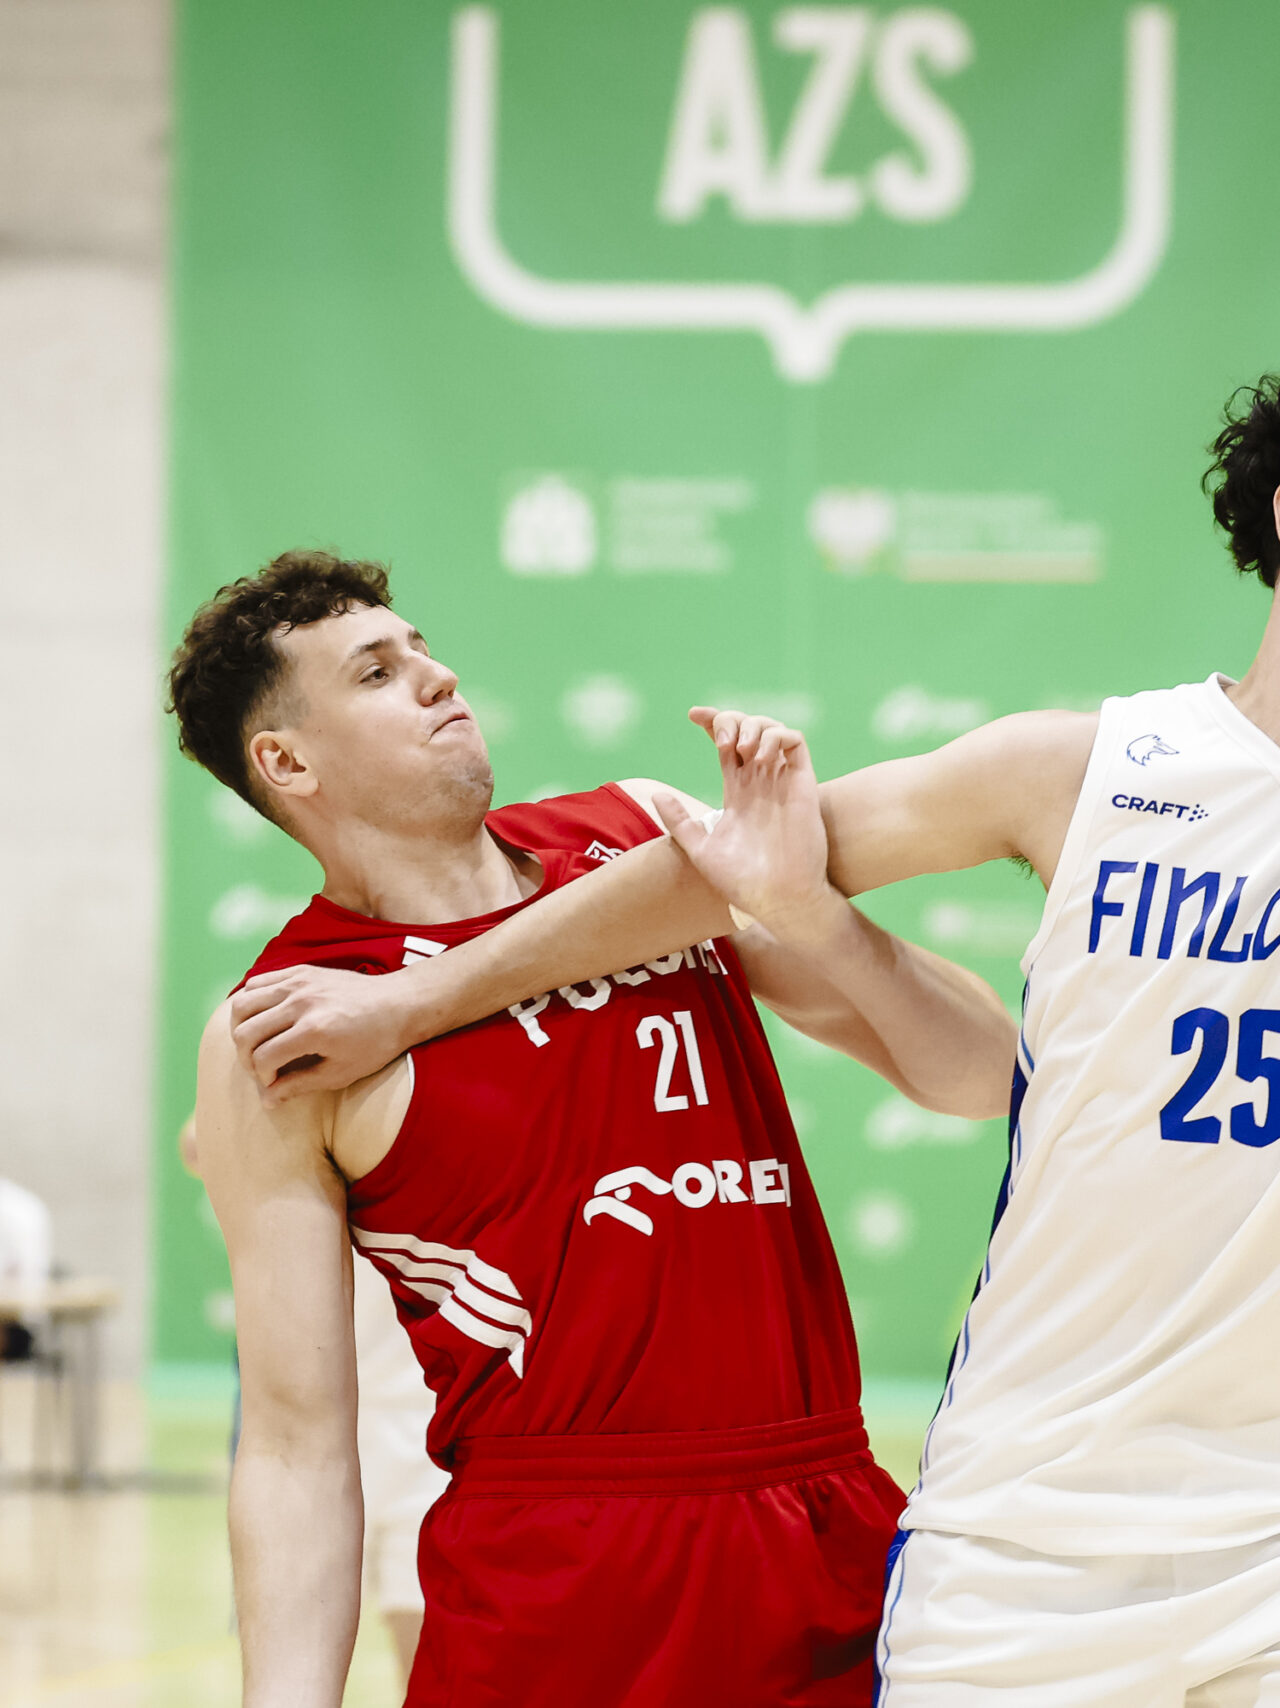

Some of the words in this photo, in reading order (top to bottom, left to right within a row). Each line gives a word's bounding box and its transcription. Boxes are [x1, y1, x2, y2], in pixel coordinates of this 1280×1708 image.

[656, 6, 975, 223] AZS
[1111, 793, 1190, 822] CRAFT
[635, 1009, 710, 1113] 21
